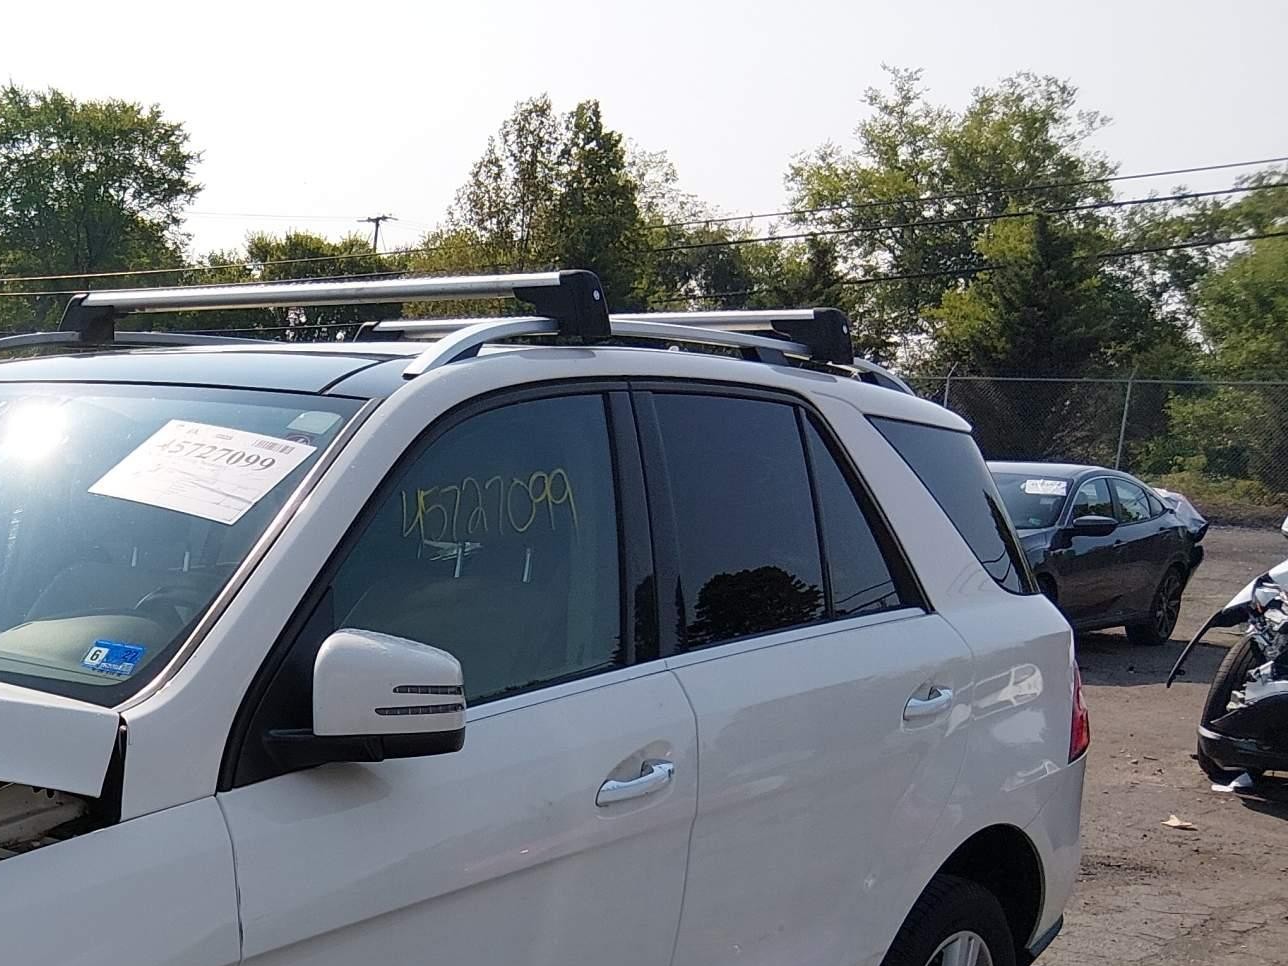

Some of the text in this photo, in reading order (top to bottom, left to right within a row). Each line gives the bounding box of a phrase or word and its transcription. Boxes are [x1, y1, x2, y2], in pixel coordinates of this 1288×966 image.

[157, 438, 276, 471] 45727099
[401, 468, 579, 542] 45727099
[90, 649, 102, 662] 6
